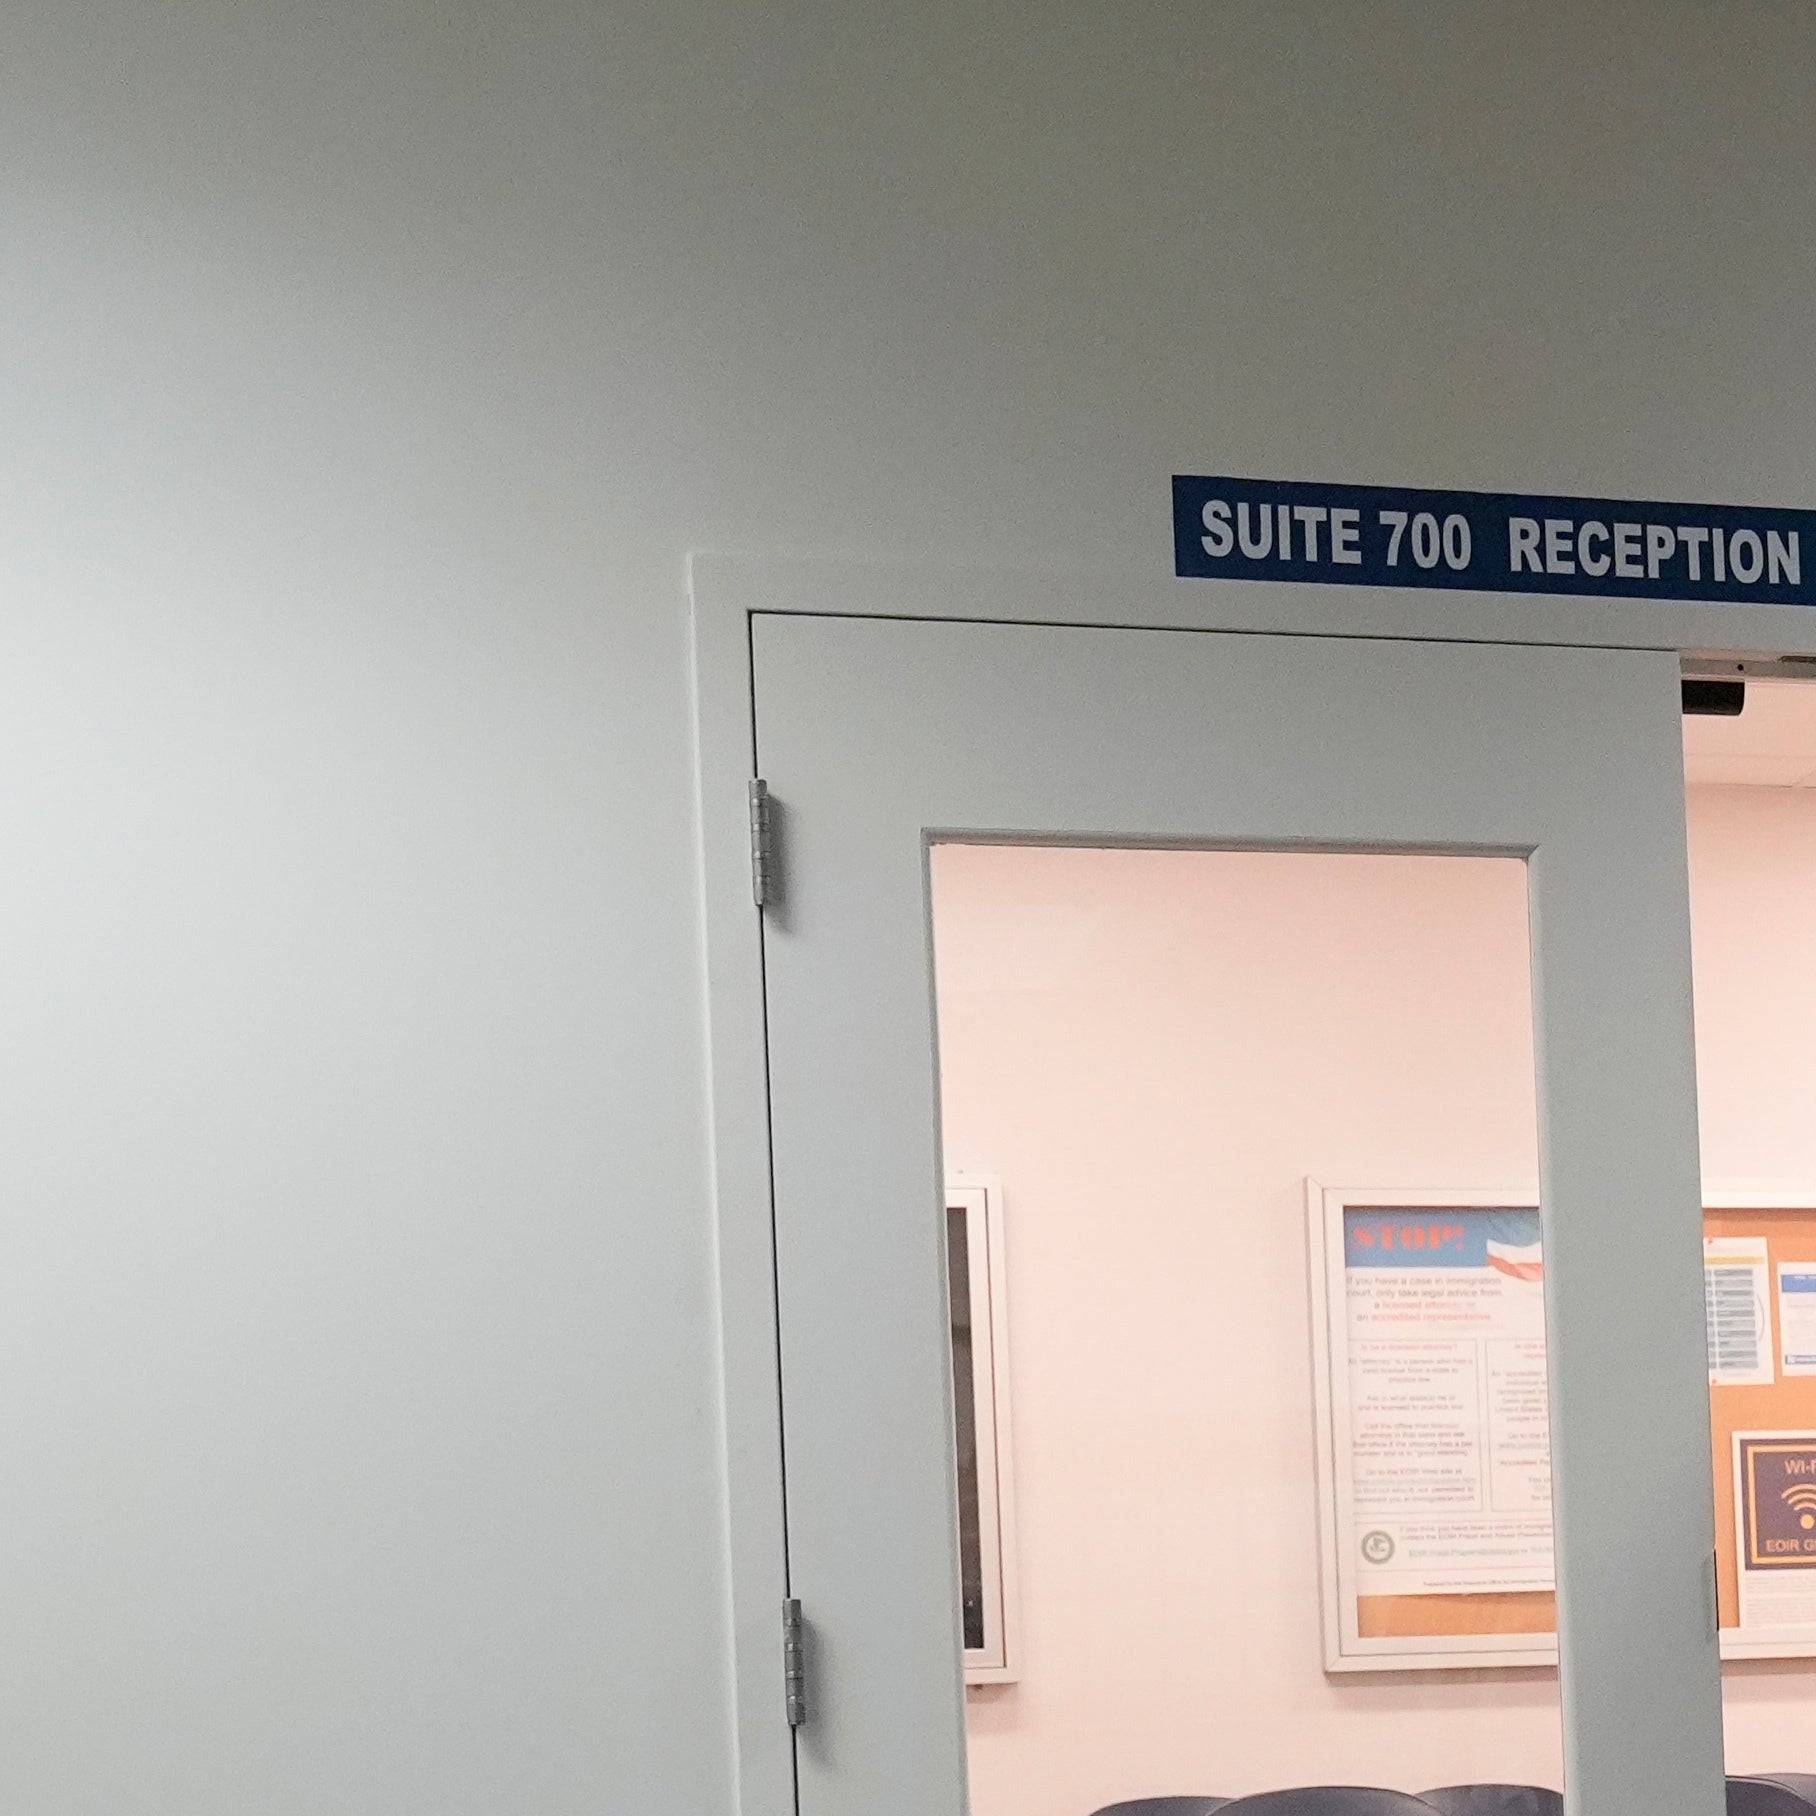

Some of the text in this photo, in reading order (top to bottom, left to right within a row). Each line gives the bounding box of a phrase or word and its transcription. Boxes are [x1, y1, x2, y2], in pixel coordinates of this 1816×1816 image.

[1201, 500, 1362, 564] SUITE
[1379, 511, 1471, 571] 700
[1508, 516, 1801, 585] RECEPTION
[1352, 1224, 1465, 1251] STOP!
[1766, 1539, 1800, 1552] EOIR
